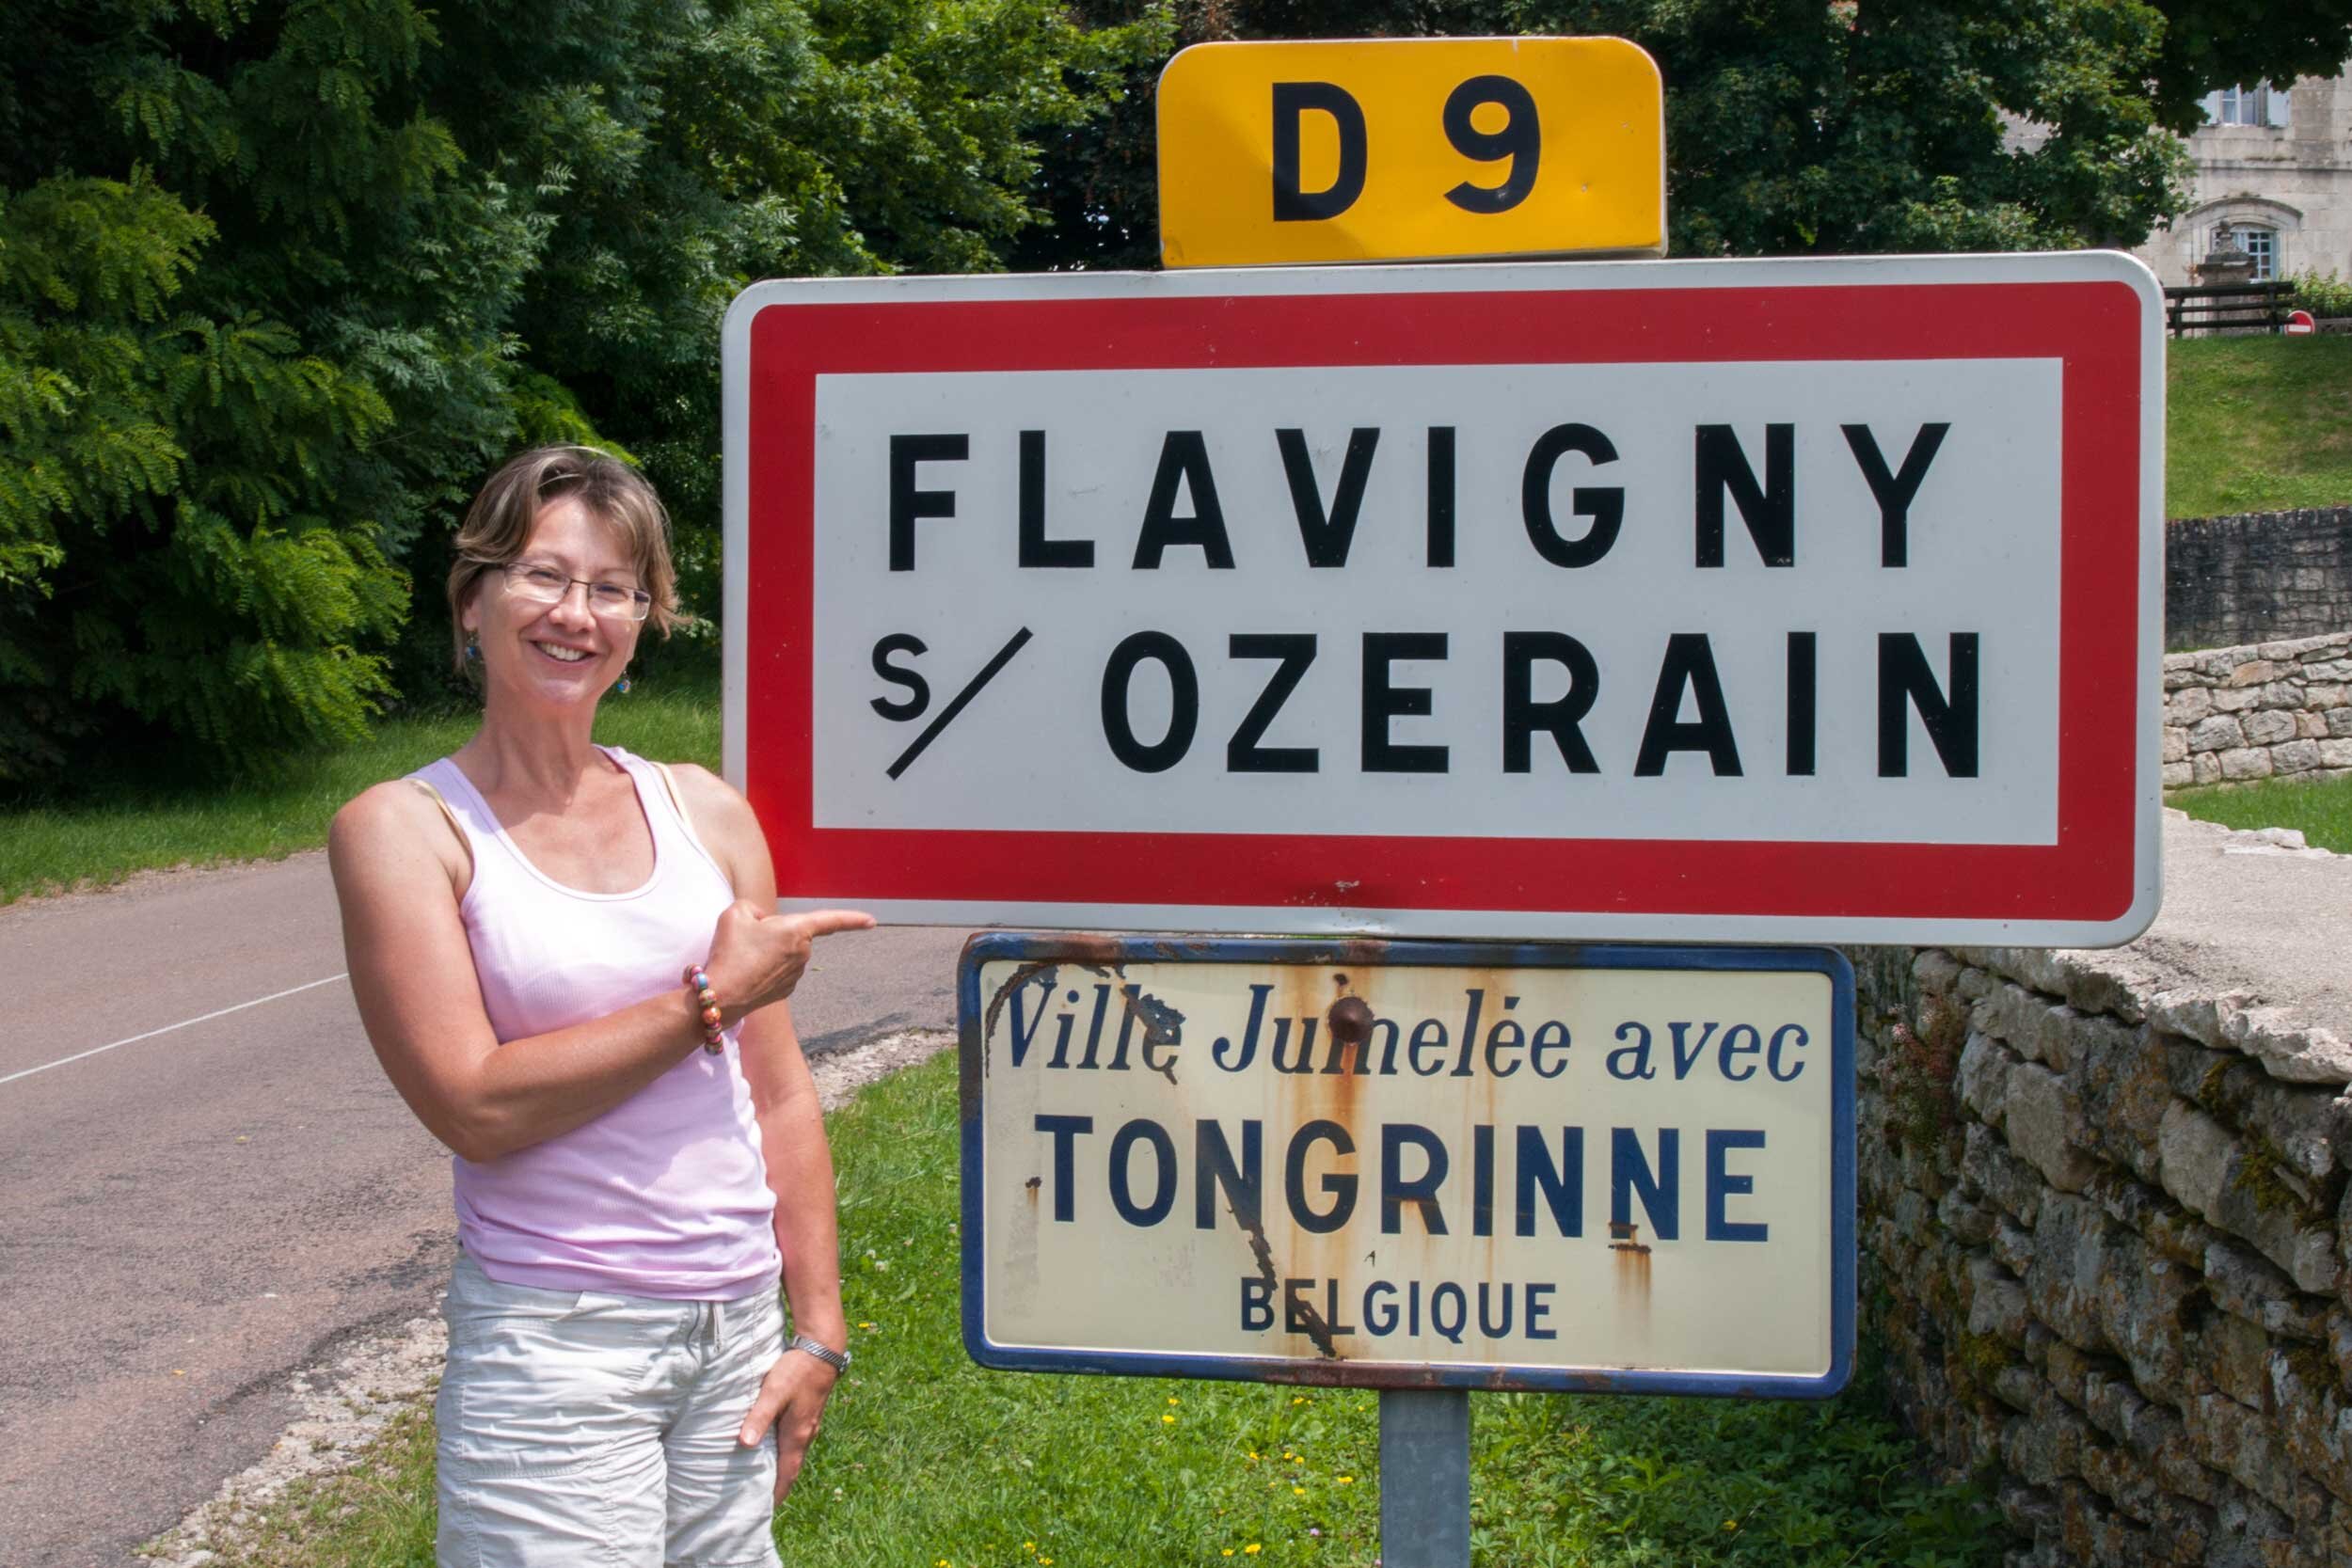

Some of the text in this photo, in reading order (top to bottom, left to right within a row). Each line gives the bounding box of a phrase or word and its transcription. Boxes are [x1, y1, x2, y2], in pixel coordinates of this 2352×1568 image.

[1272, 74, 1541, 222] D 9
[889, 422, 1951, 572] FLAVIGNY
[1101, 630, 1979, 779] OZERAIN
[1007, 980, 1809, 1082] Ville Jumelée avec
[1034, 1114, 1769, 1243] TONGRINNE
[1240, 1275, 1558, 1345] BELGIQUE
